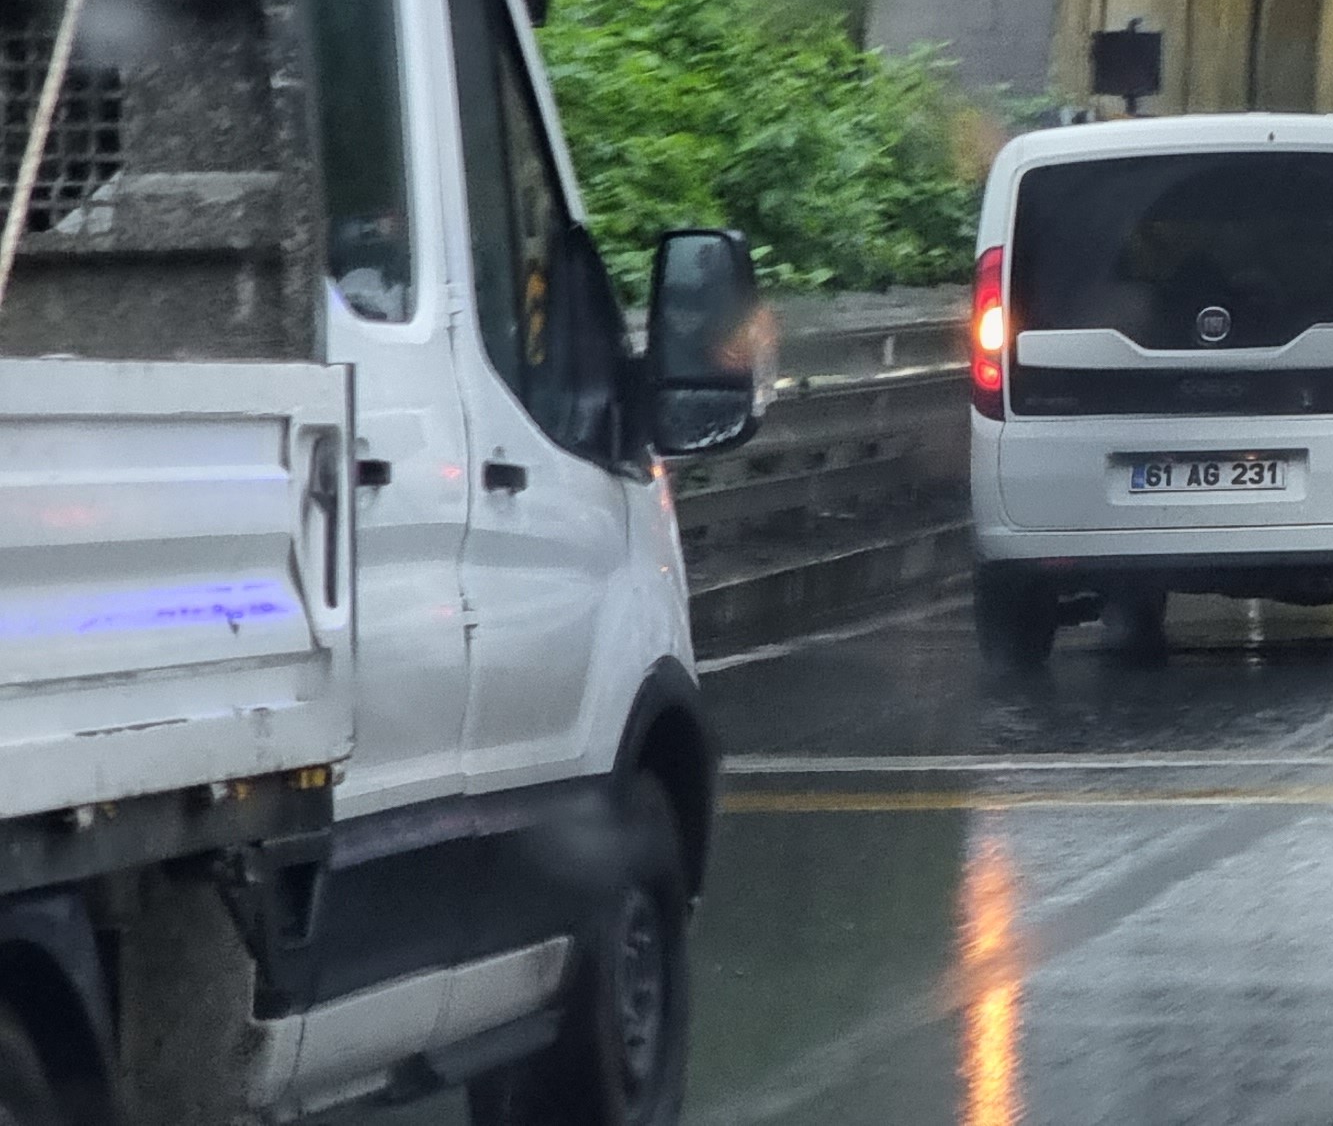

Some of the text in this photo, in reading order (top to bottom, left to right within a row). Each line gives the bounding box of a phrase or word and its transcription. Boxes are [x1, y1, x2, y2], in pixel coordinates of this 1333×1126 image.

[1146, 462, 1278, 486] 61 AG 231
